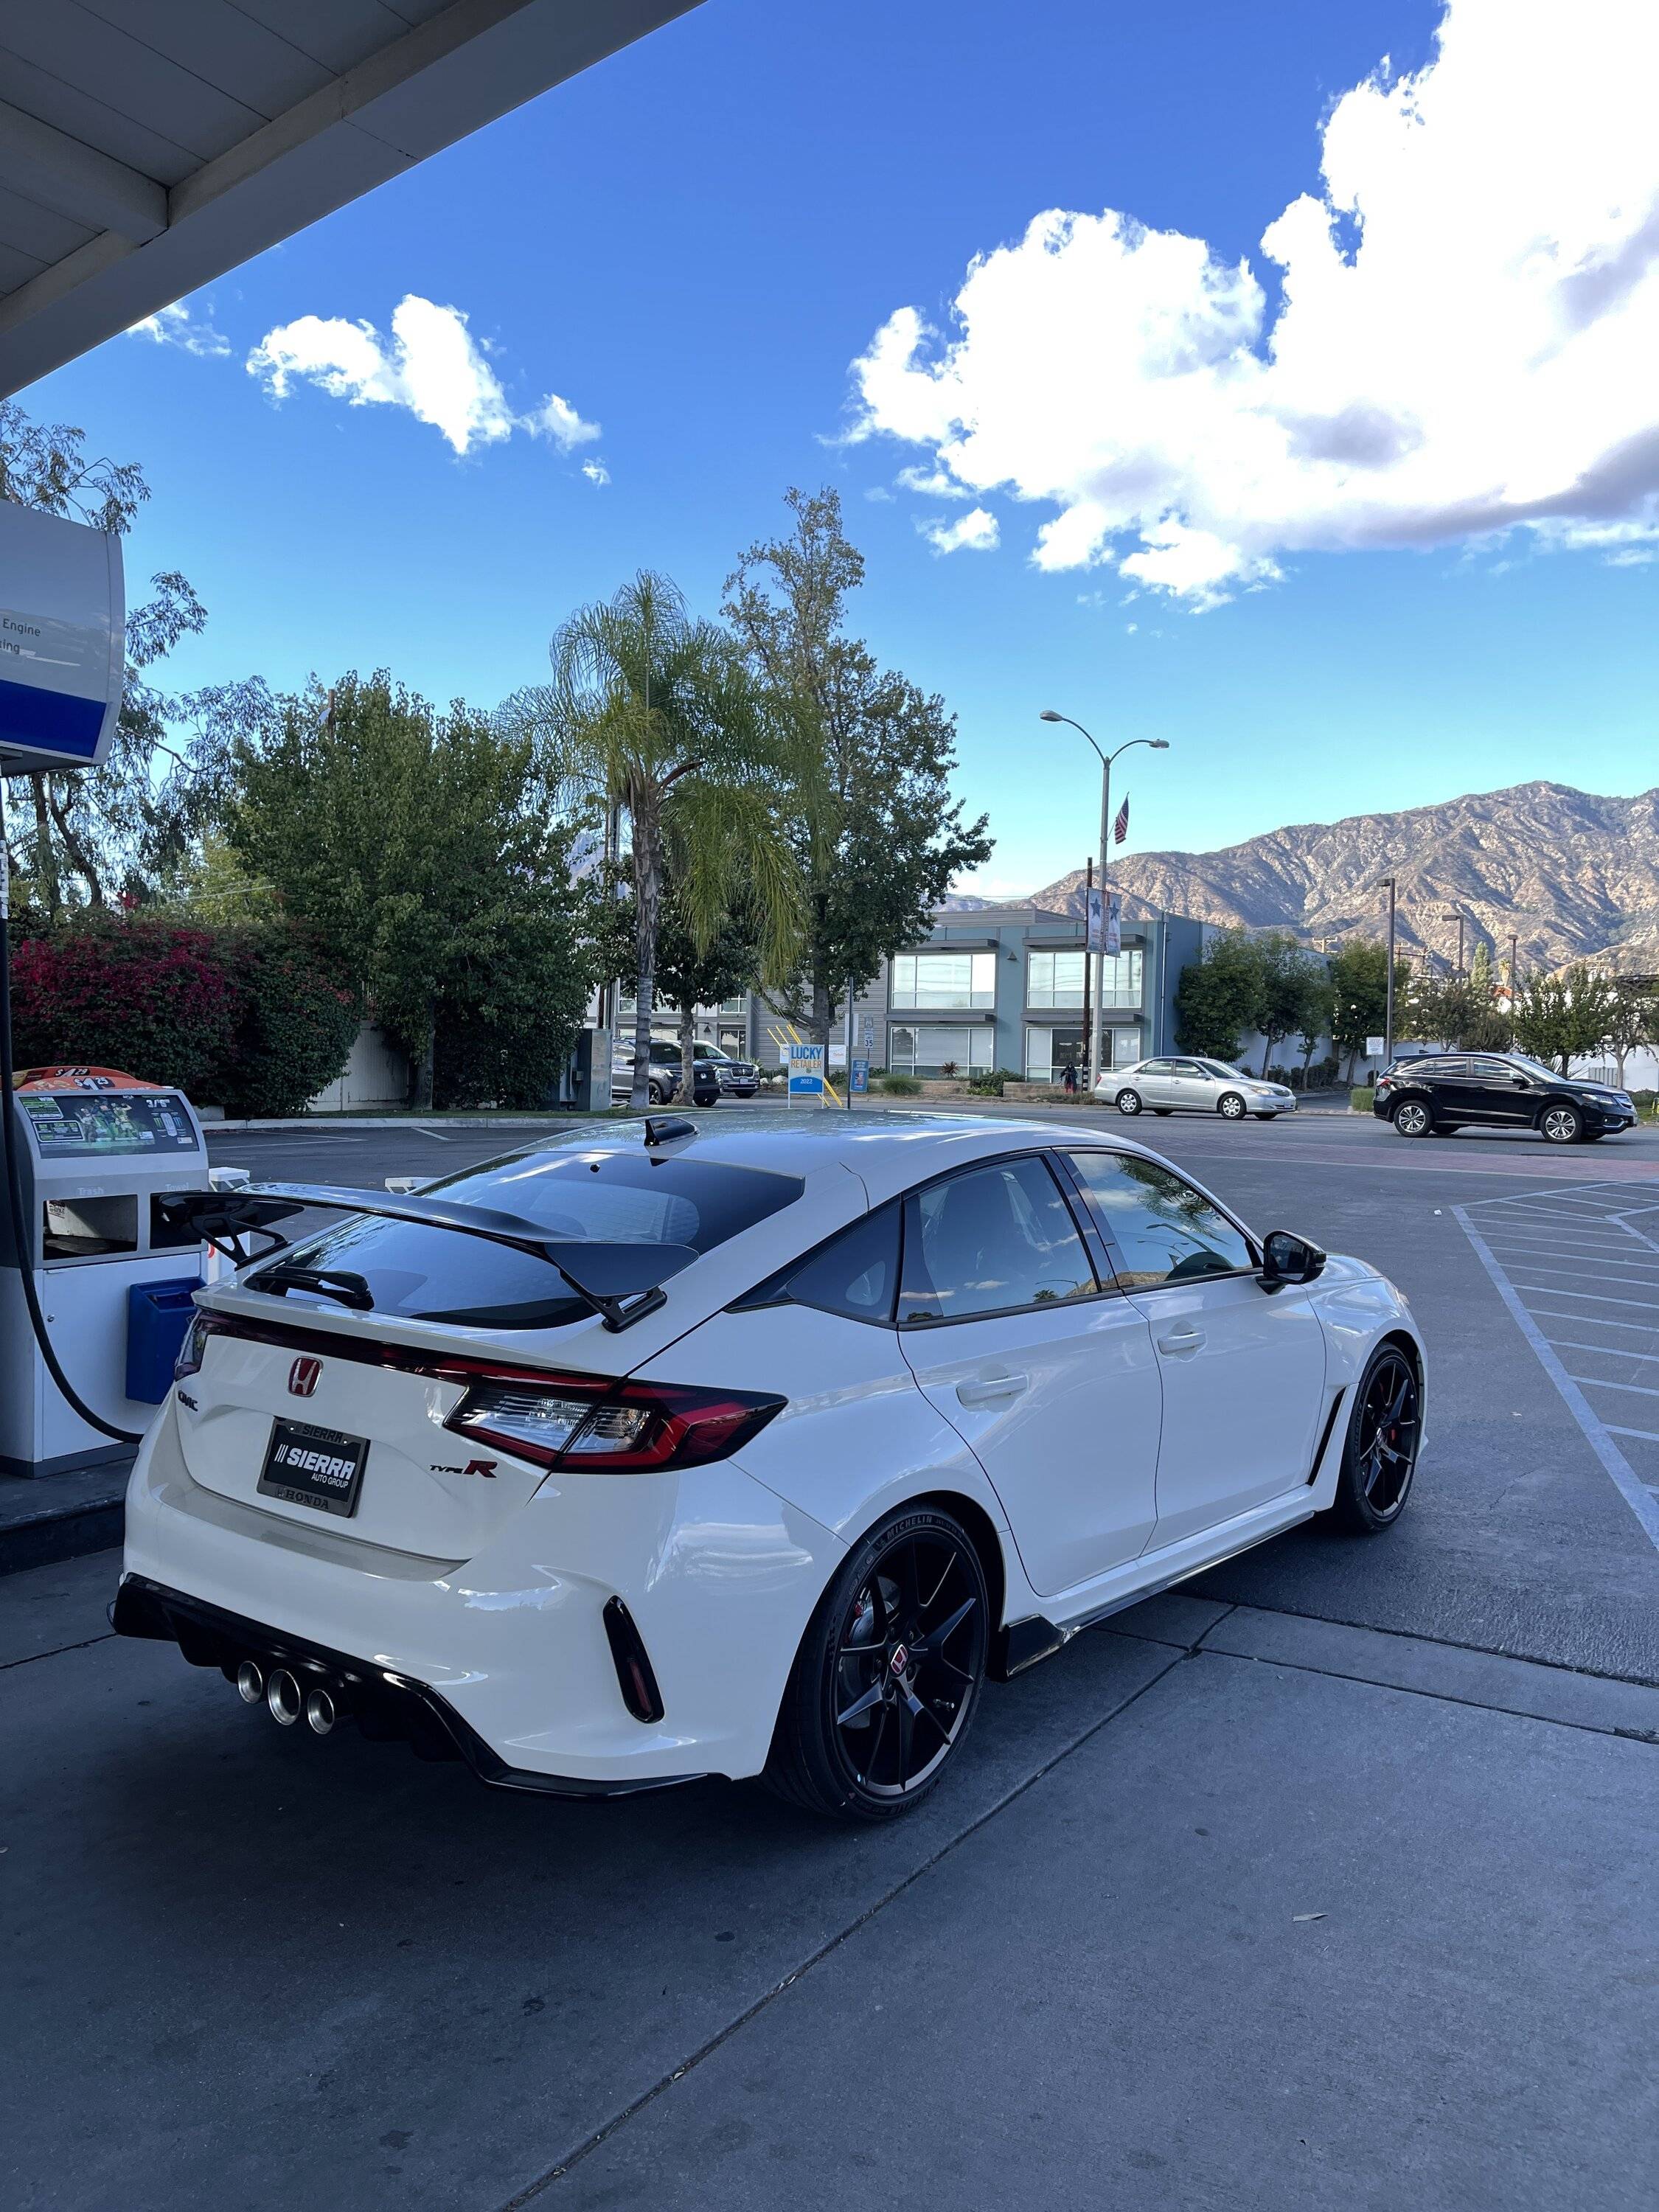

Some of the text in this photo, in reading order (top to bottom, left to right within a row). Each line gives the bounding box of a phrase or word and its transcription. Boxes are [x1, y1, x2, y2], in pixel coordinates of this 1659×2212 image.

[3, 618, 41, 636] Engine
[0, 638, 20, 655] ing
[790, 1046, 822, 1060] LUCKY
[790, 1060, 822, 1068] RETAILER
[77, 1186, 105, 1196] Trash
[165, 1183, 189, 1192] Towel
[178, 1390, 198, 1412] CIVIC
[302, 1424, 344, 1444] SIERRA
[286, 1447, 356, 1480] SIERRA
[430, 1459, 498, 1478] TYPE R
[311, 1472, 349, 1489] AUTO GROUP
[285, 1489, 330, 1509] HONDA
[887, 1515, 932, 1540] MICHELIN
